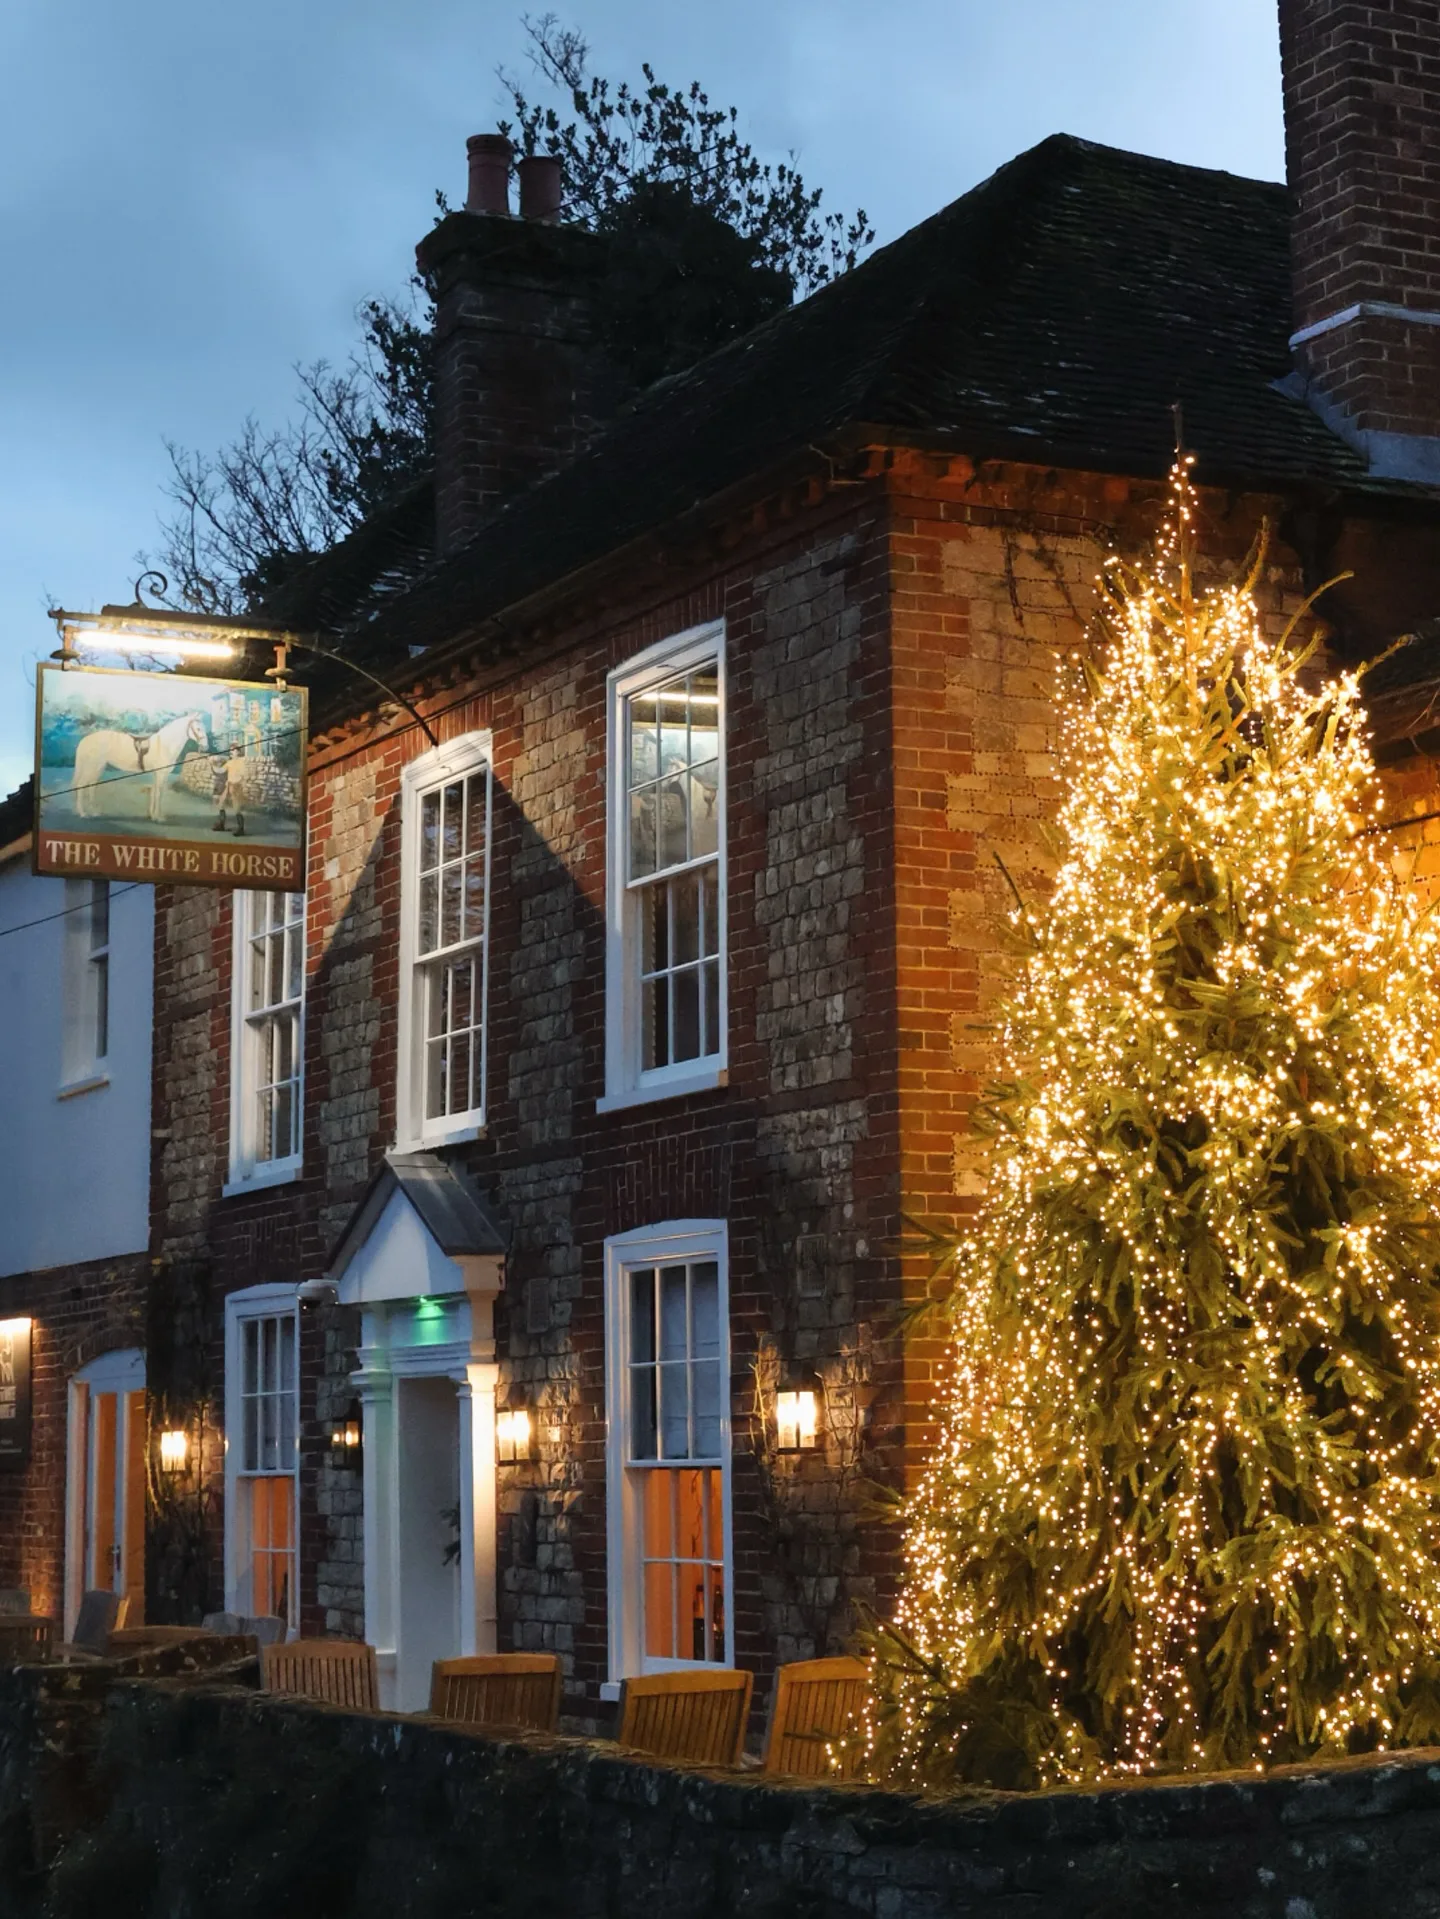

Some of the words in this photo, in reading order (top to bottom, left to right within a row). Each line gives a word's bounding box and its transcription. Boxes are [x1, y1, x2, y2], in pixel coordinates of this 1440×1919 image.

[46, 840, 100, 865] THE
[112, 844, 200, 873] WHITE
[211, 852, 294, 879] HORSE
